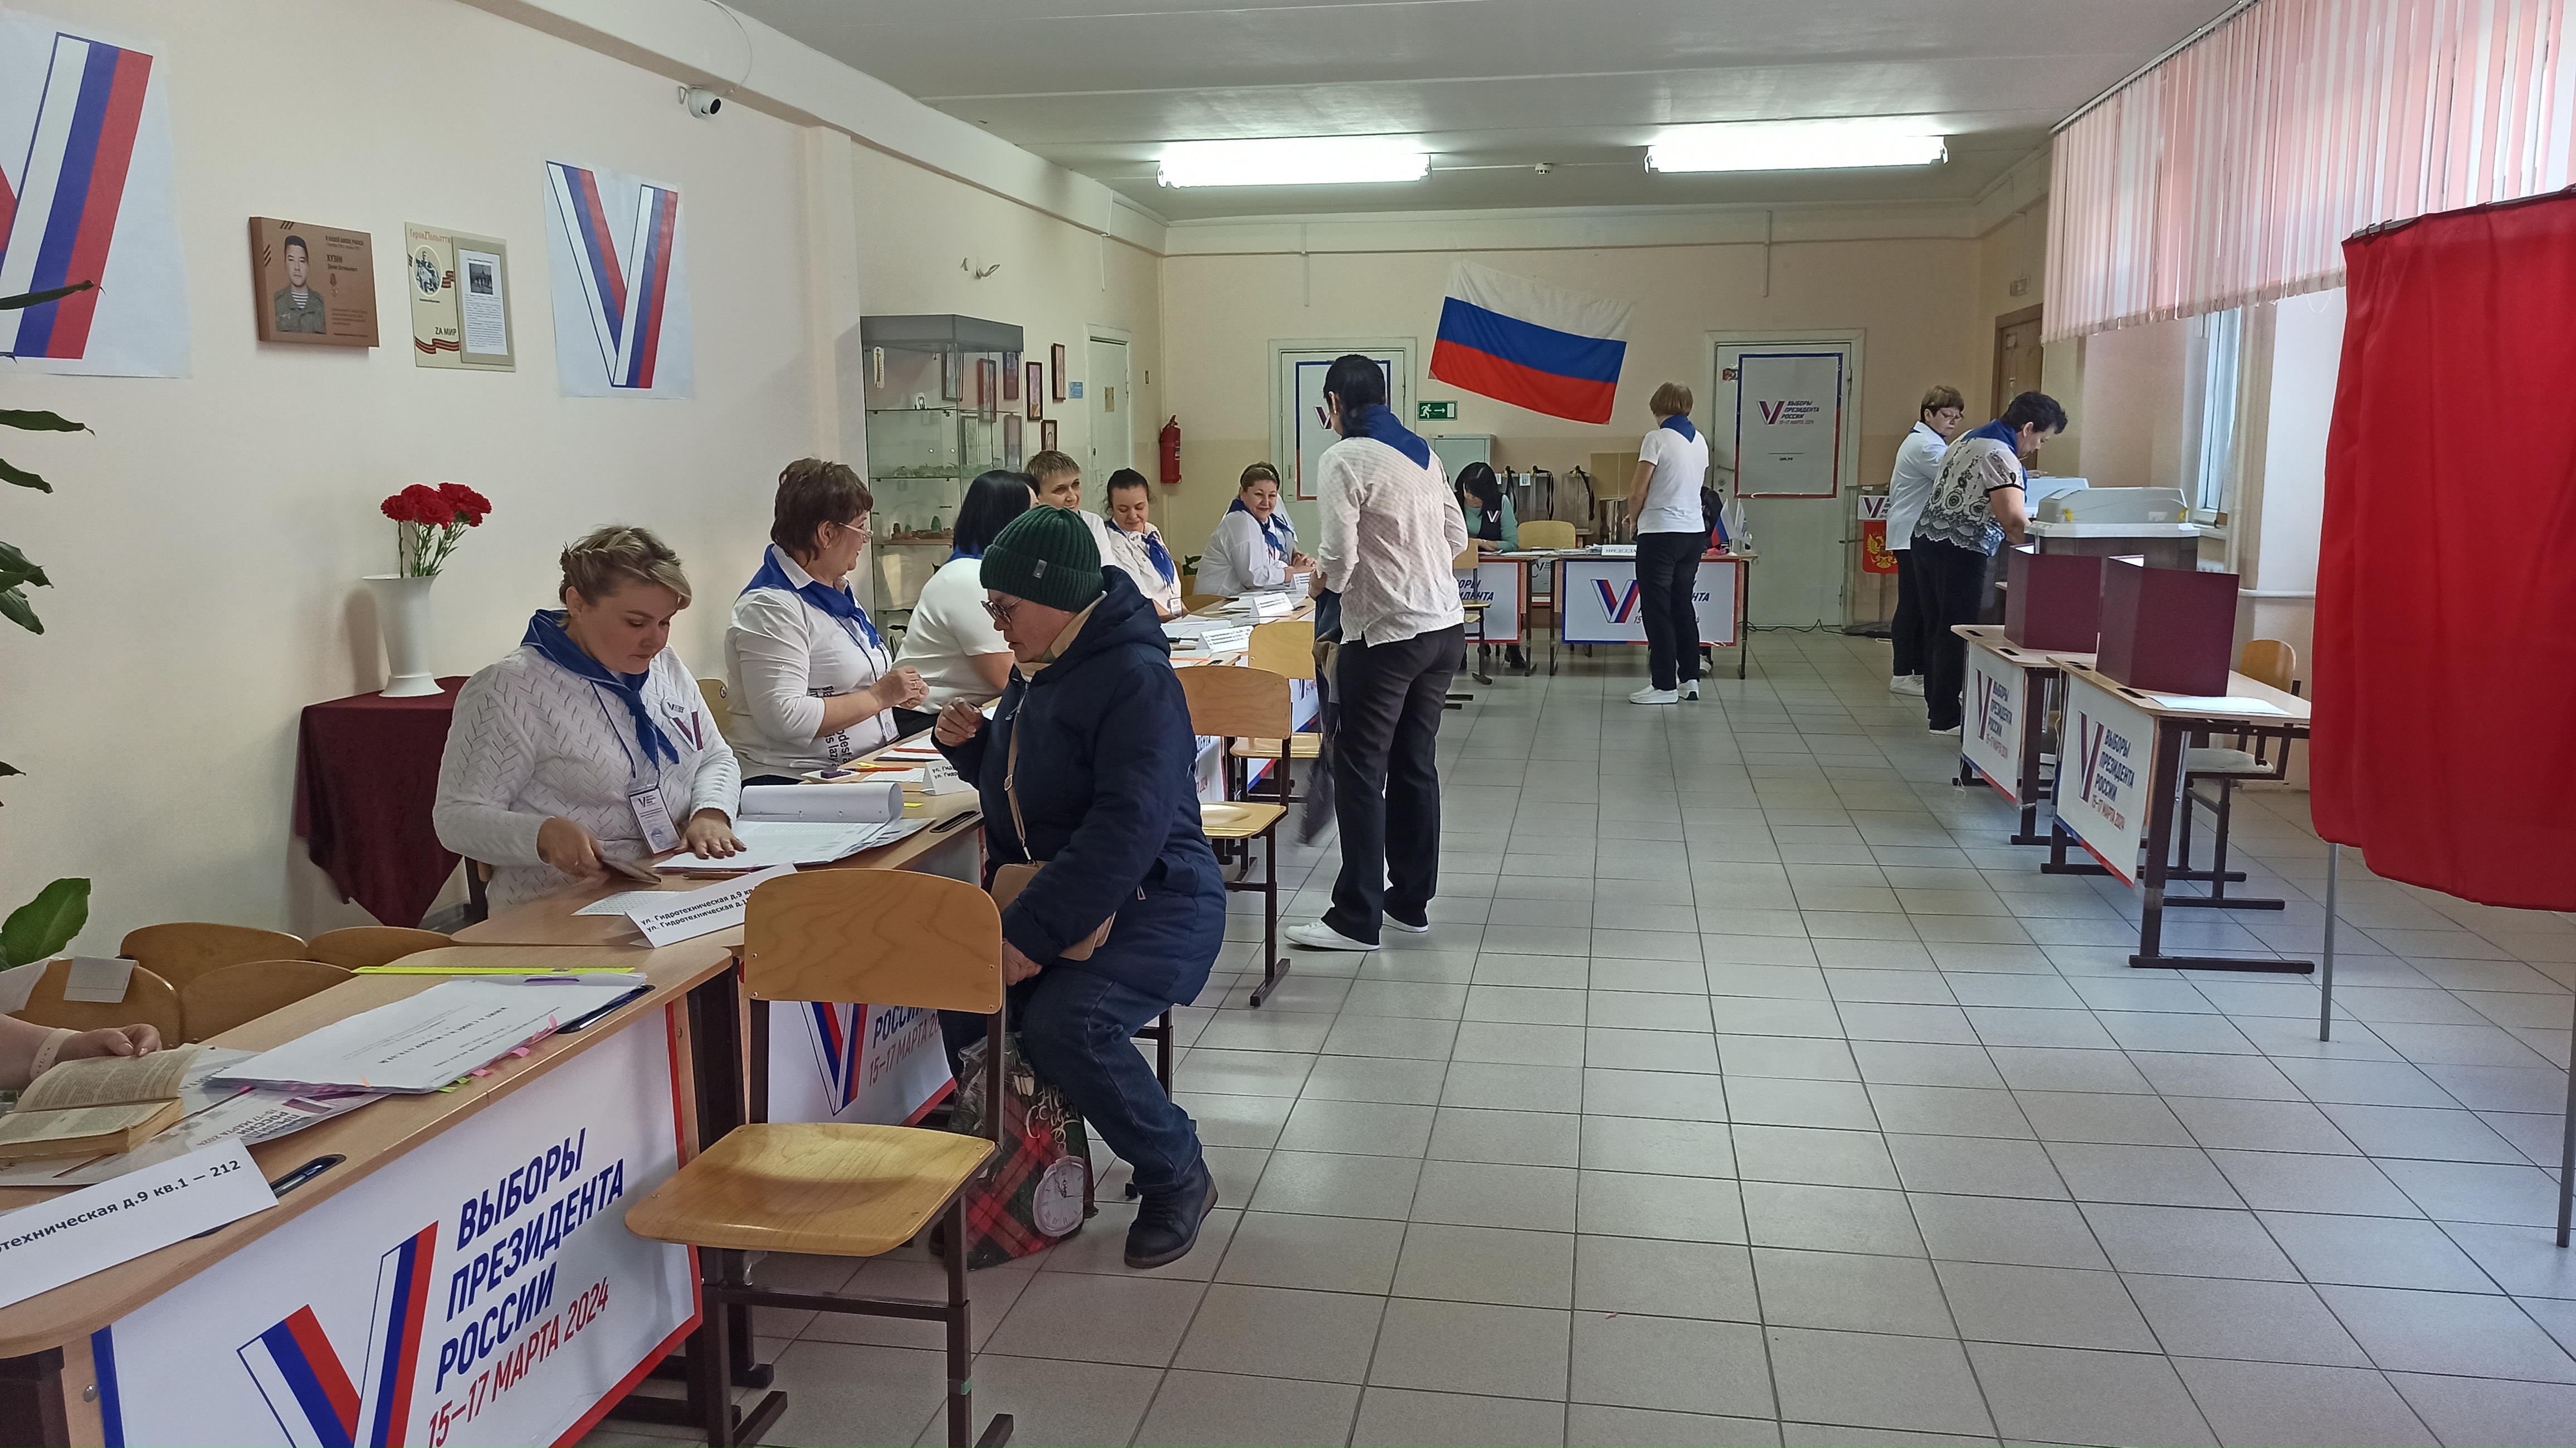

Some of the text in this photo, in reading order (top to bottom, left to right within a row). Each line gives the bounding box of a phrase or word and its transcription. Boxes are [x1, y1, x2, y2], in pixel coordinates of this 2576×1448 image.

[828, 745, 840, 762] lazy
[2104, 729, 2131, 759] ВЫБОРЫ
[2094, 773, 2118, 802] РОССИИ
[2099, 751, 2135, 789] ПРЕЗИДЕНТА
[641, 917, 654, 926] ул.
[654, 896, 729, 922] Гидротехническая
[730, 891, 743, 901] д.9
[660, 903, 734, 929] Гидротехническая
[896, 1019, 928, 1064] МАРТА
[929, 1012, 939, 1038] 20
[219, 1121, 252, 1136] МАРТА
[237, 1112, 289, 1134] РОССИИ
[197, 1136, 221, 1146] 2024
[122, 1190, 149, 1212] д.9
[152, 1176, 189, 1198] кв.1
[209, 1159, 241, 1179] 212
[457, 1127, 587, 1251] ВЫБОРЫ
[446, 1158, 625, 1322] ПРЕЗИДЕНТА
[436, 1261, 558, 1394] РОССИИ
[491, 1313, 560, 1403] МАРТА
[564, 1276, 610, 1344] 2024
